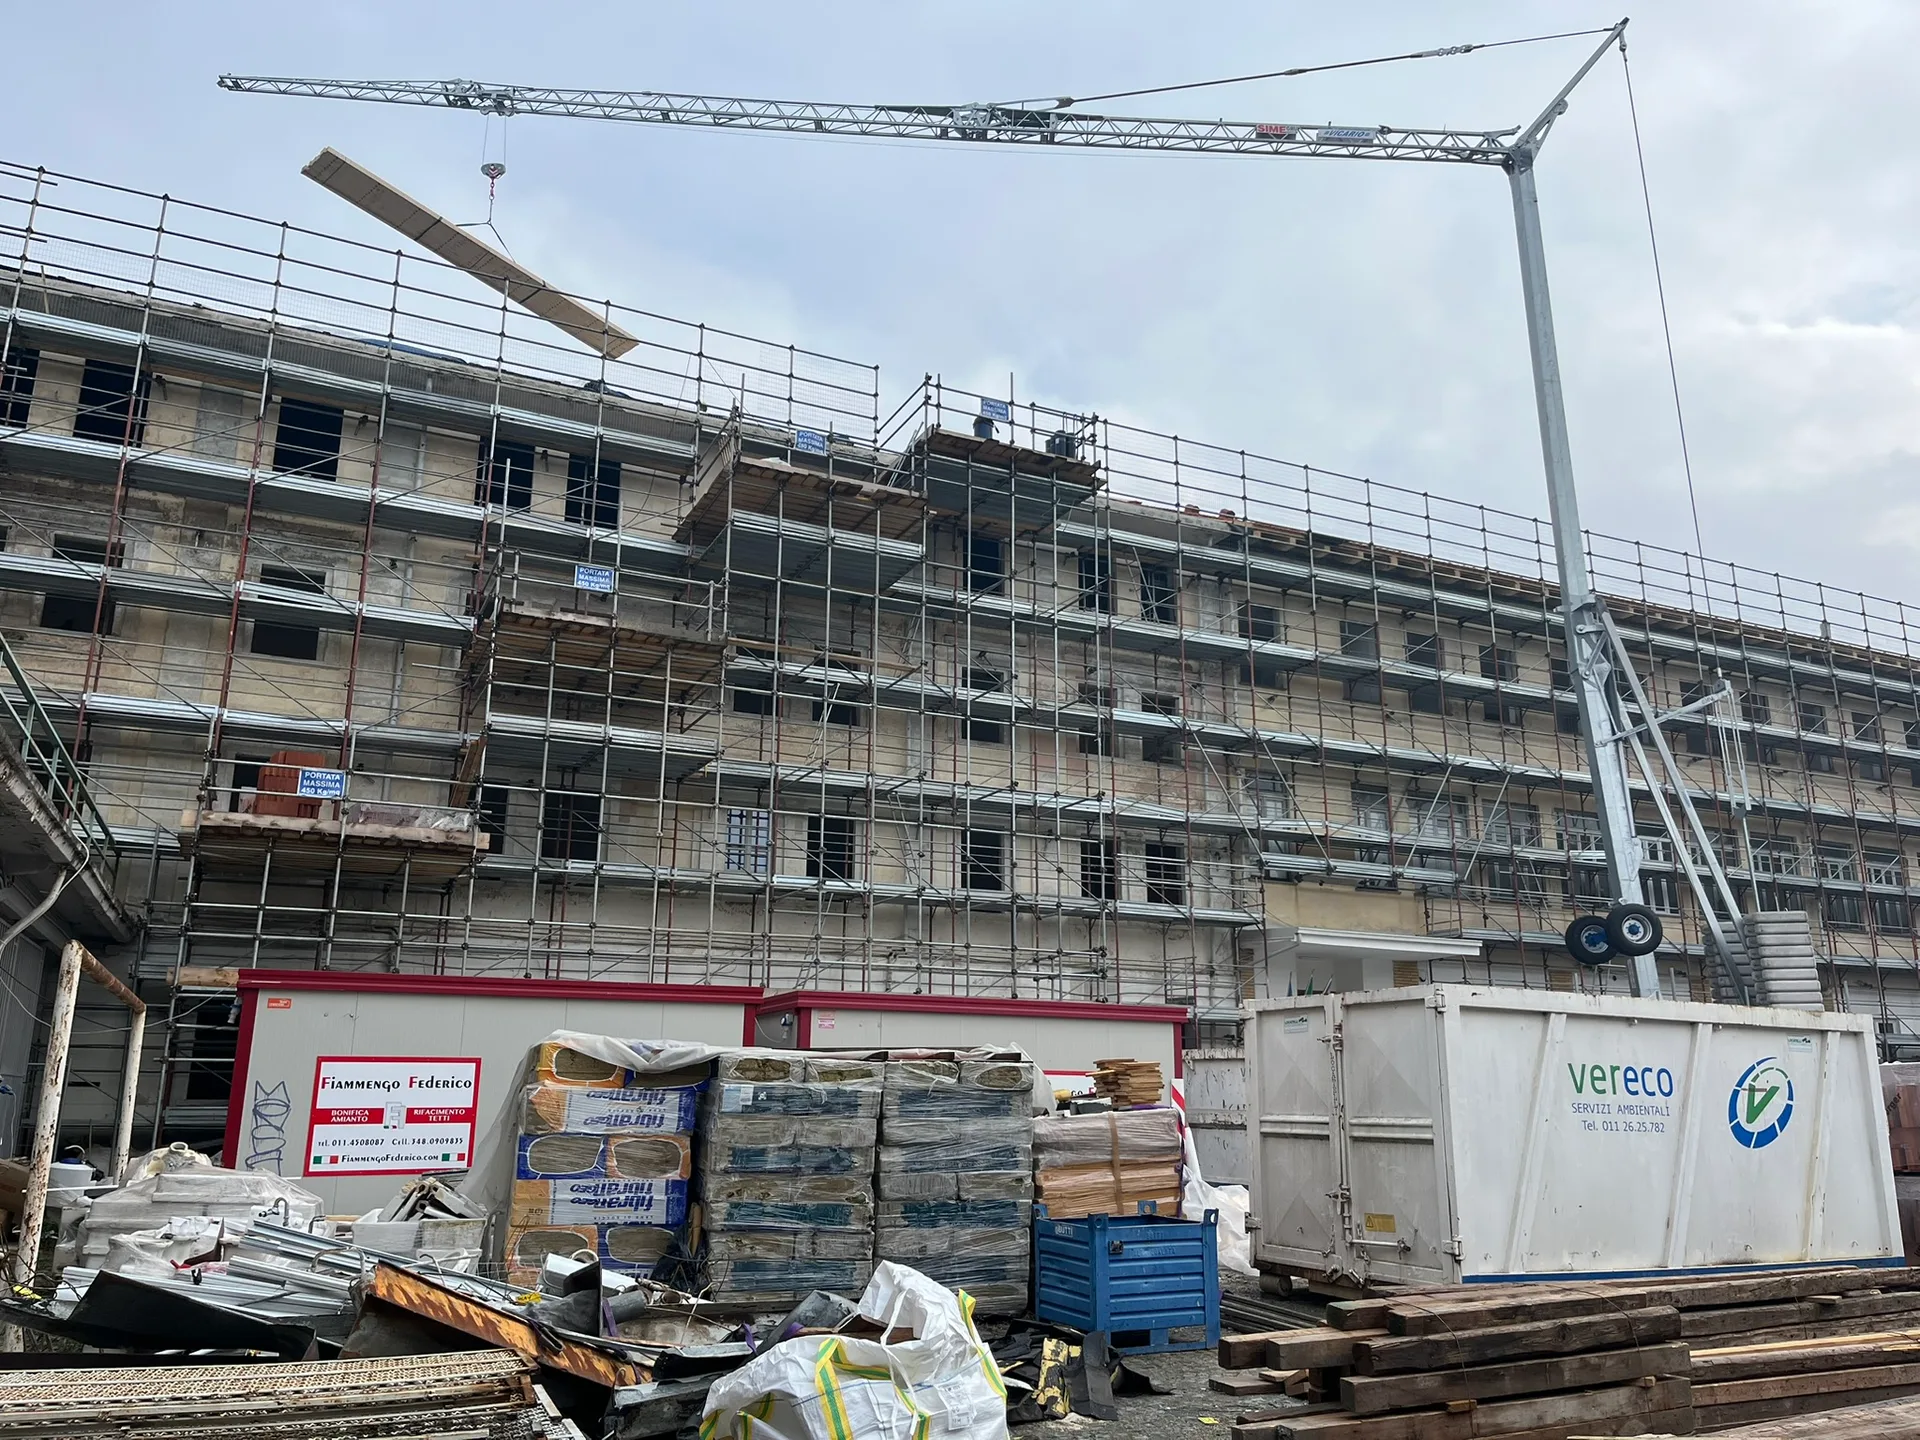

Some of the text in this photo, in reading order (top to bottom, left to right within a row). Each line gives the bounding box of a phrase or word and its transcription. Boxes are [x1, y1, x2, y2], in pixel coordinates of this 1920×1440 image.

[1257, 124, 1286, 133] SIME
[579, 567, 610, 576] PORTATA
[578, 574, 610, 583] MASSIMA
[304, 772, 341, 780] PORTATA
[302, 779, 341, 788] MASSIMA
[1567, 1063, 1674, 1098] vereco
[1571, 1103, 1670, 1116] SERVIZI AMBIENTALI
[1582, 1120, 1665, 1133] Tel. 011 26.25.782
